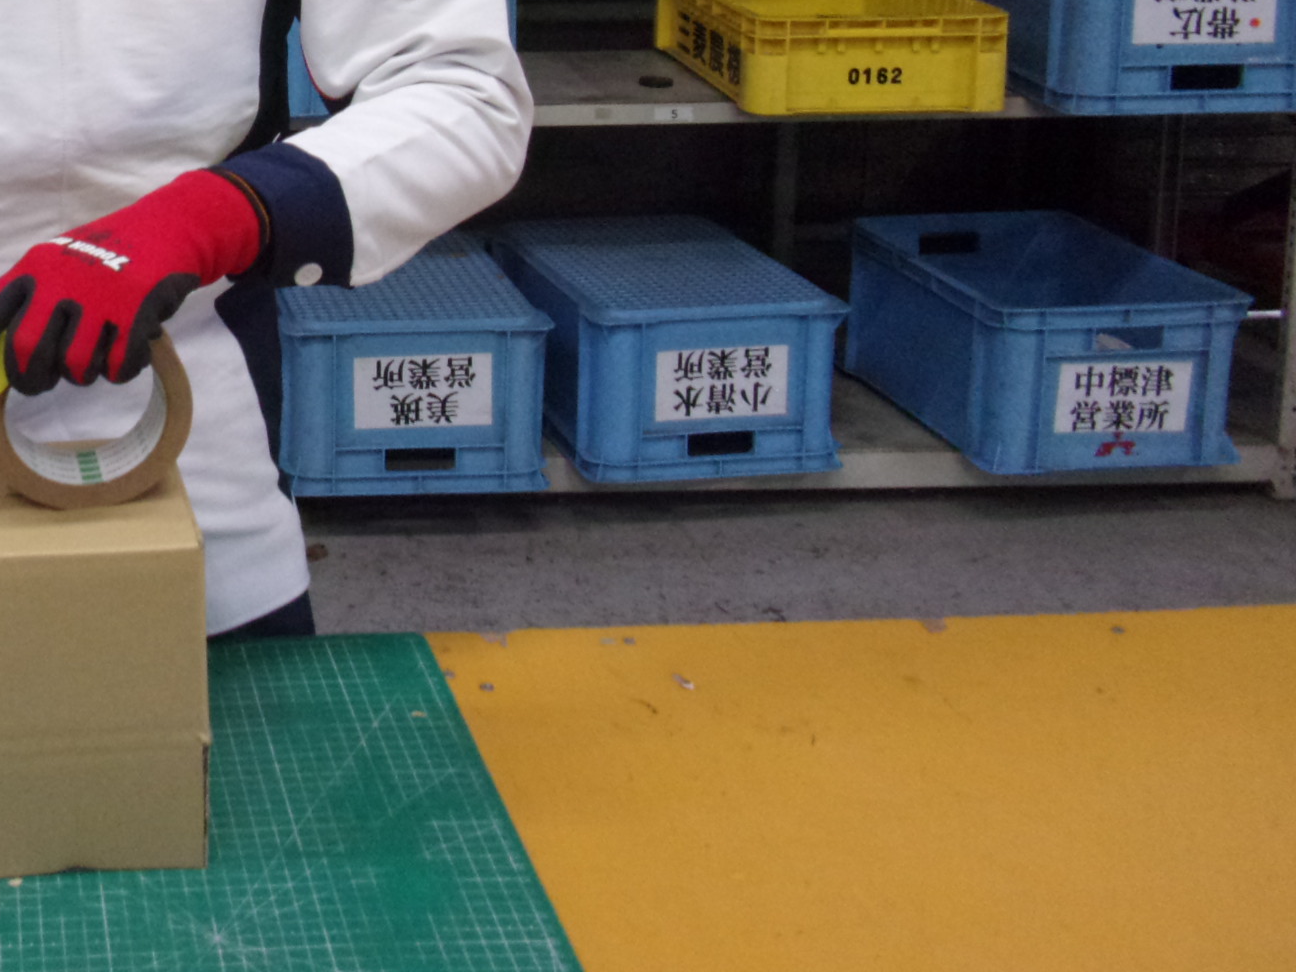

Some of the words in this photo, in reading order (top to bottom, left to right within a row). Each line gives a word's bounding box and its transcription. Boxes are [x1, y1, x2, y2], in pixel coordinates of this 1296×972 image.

[1170, 7, 1241, 41] 帯広
[847, 67, 903, 87] 0162
[372, 356, 476, 389] 営業所
[673, 347, 773, 379] 営業所
[1074, 365, 1175, 397] 中標津
[391, 392, 460, 426] 美瑛
[673, 381, 772, 417] 小清水
[1070, 401, 1170, 432] 営業所
